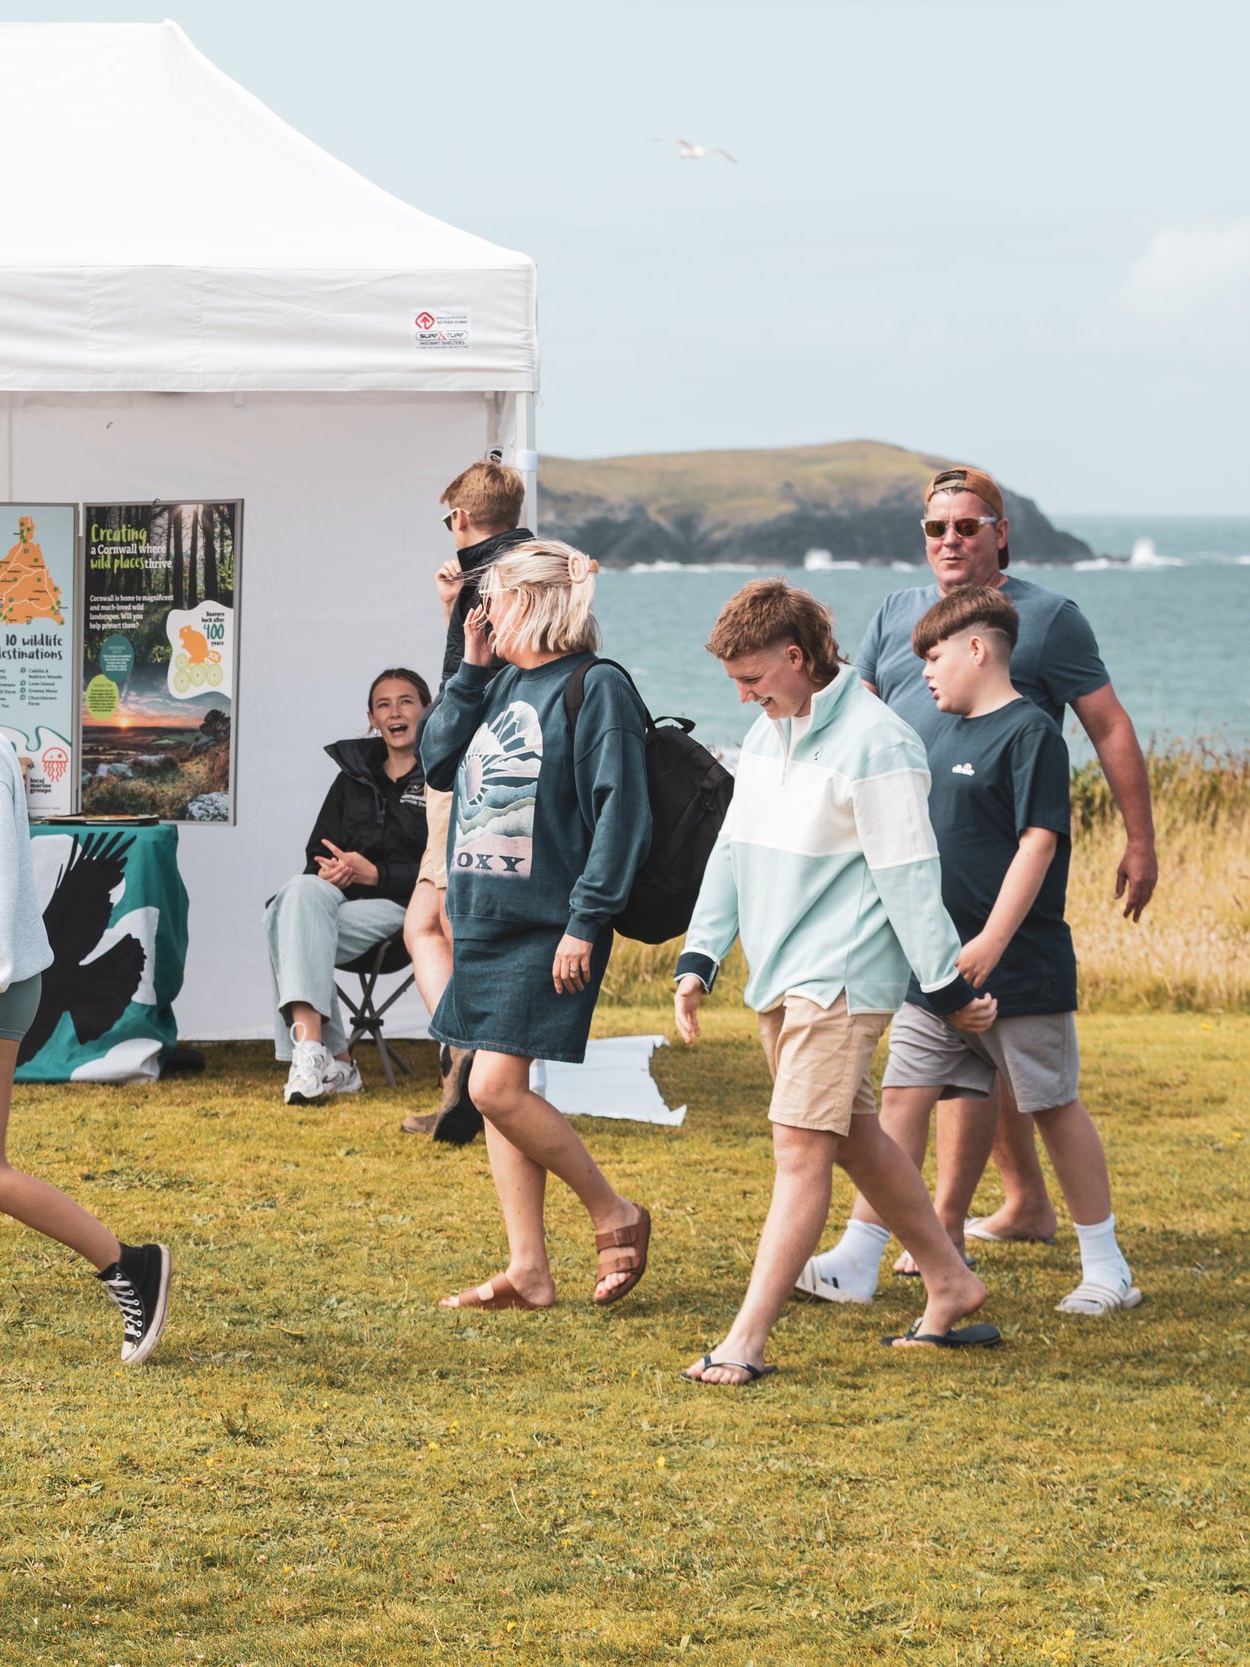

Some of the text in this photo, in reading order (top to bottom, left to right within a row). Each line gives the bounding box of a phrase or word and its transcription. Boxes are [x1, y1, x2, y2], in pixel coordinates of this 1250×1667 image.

[91, 524, 147, 546] Creating
[91, 543, 167, 555] a Cornwall where
[90, 554, 173, 574] wild places thrive
[90, 594, 114, 602] Cornwall
[114, 594, 120, 602] is
[120, 594, 135, 602] home
[142, 594, 174, 603] magnificent
[120, 612, 132, 620] Will
[89, 622, 101, 630] help
[102, 622, 122, 631] protect
[203, 623, 225, 640] 400
[6, 633, 63, 647] 10 wildlife
[452, 852, 526, 873] OXY
